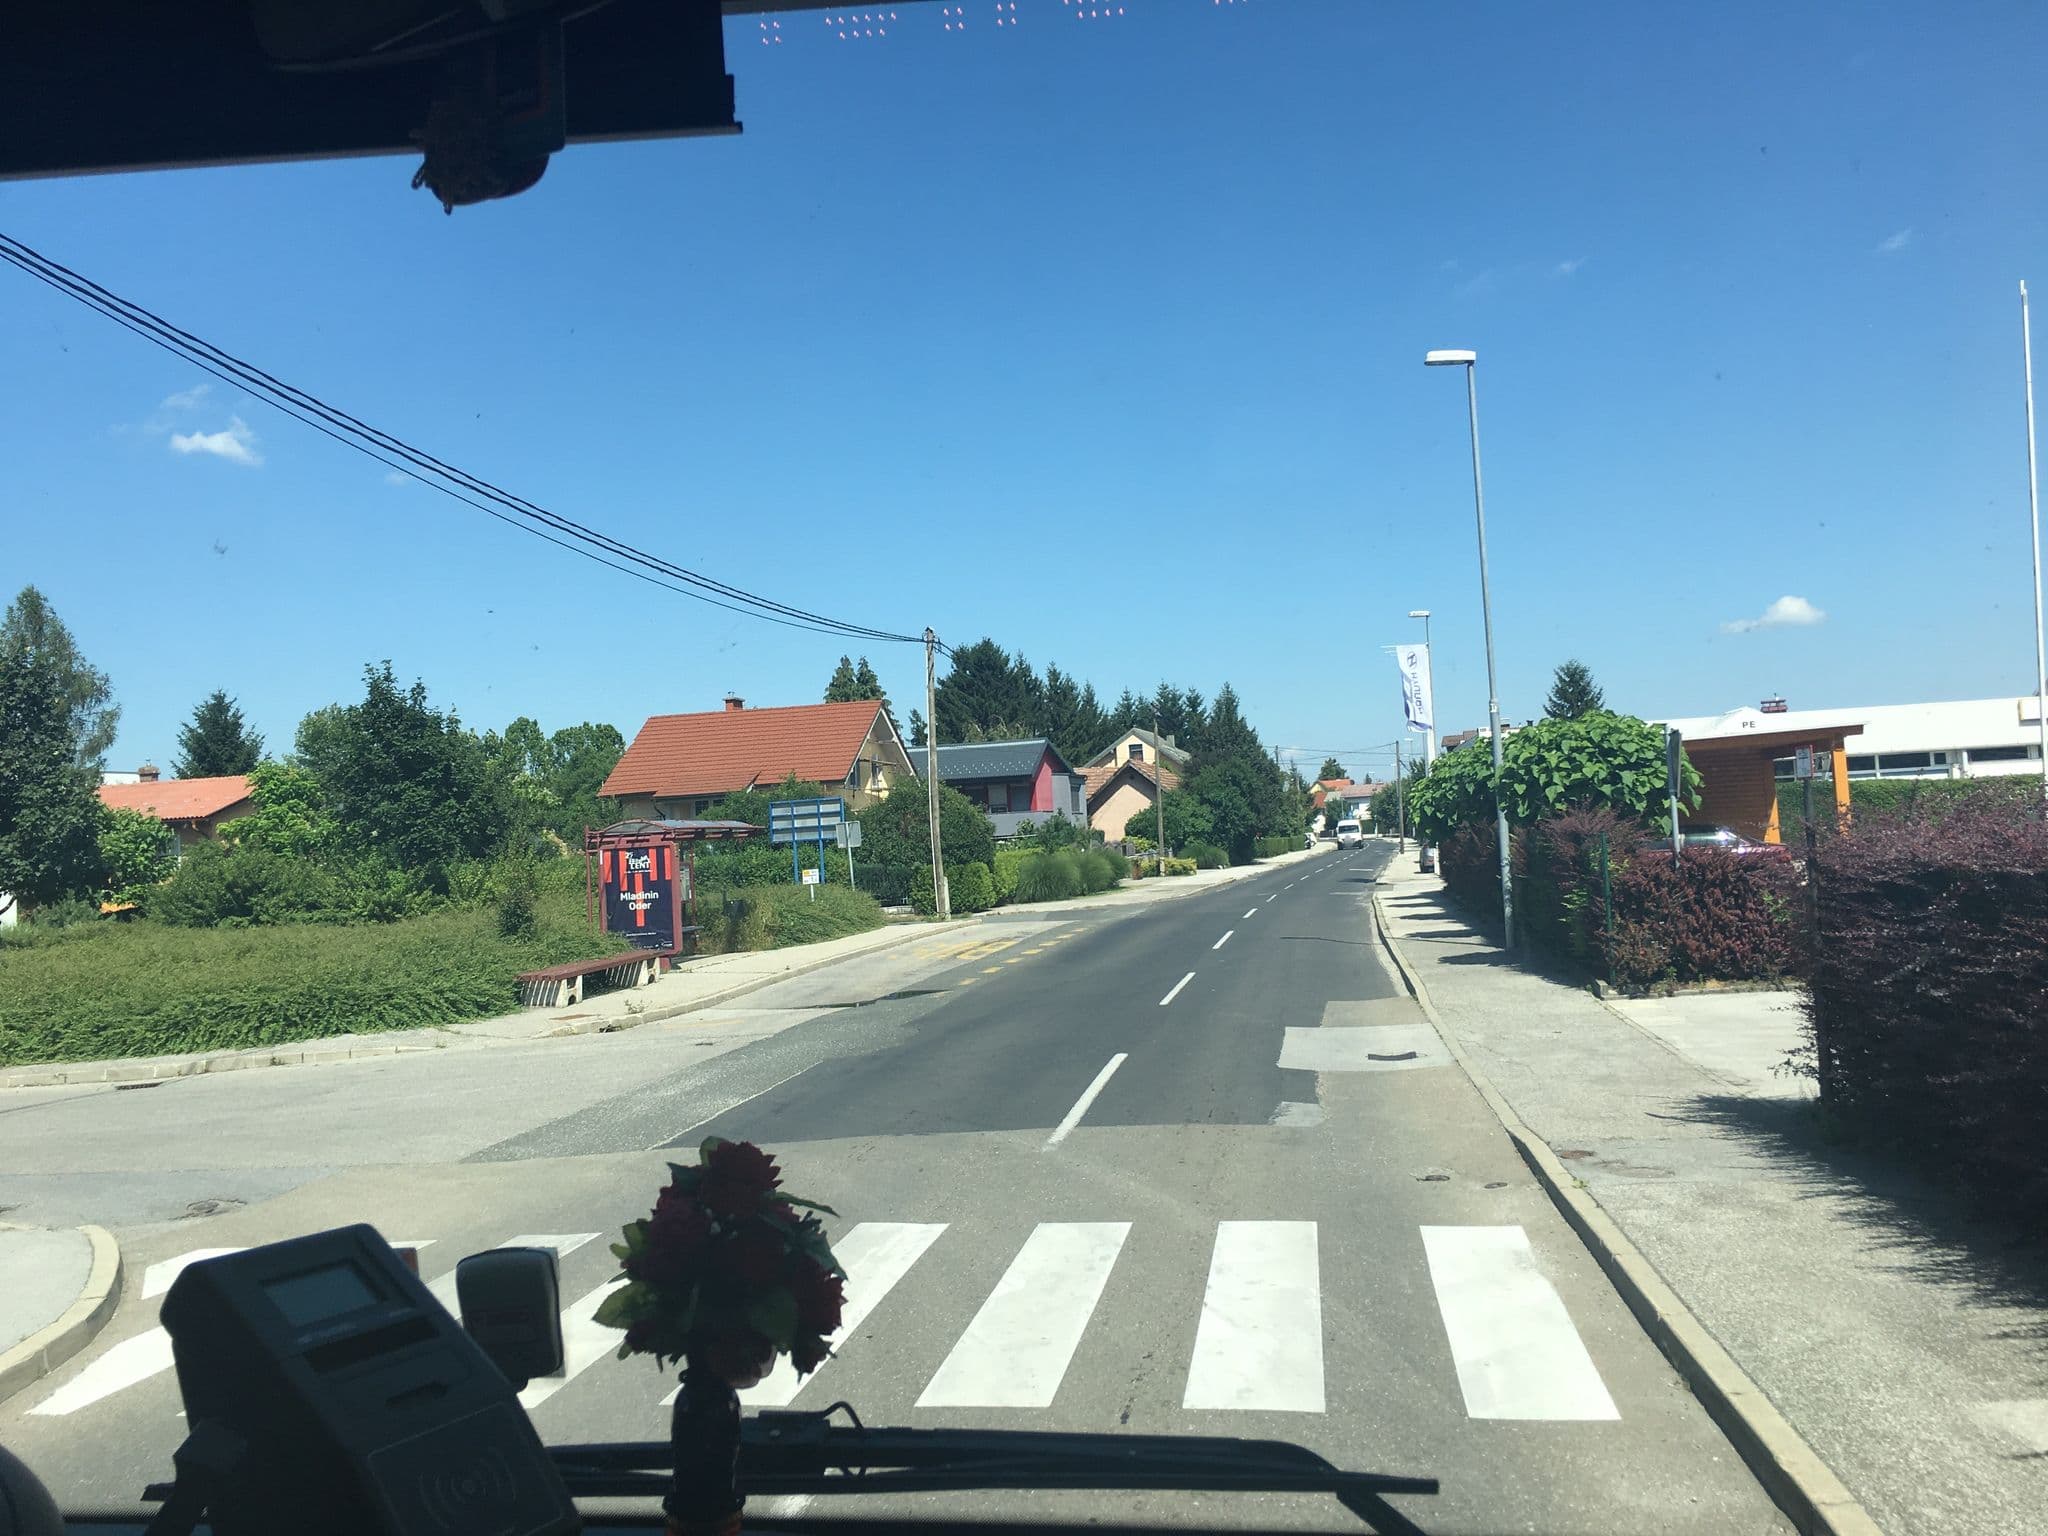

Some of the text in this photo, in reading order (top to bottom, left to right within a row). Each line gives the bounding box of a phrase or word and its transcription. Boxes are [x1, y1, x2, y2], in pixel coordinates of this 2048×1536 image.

[1742, 720, 1756, 728] PE
[620, 891, 659, 901] Mladinin
[629, 902, 652, 911] Oder
